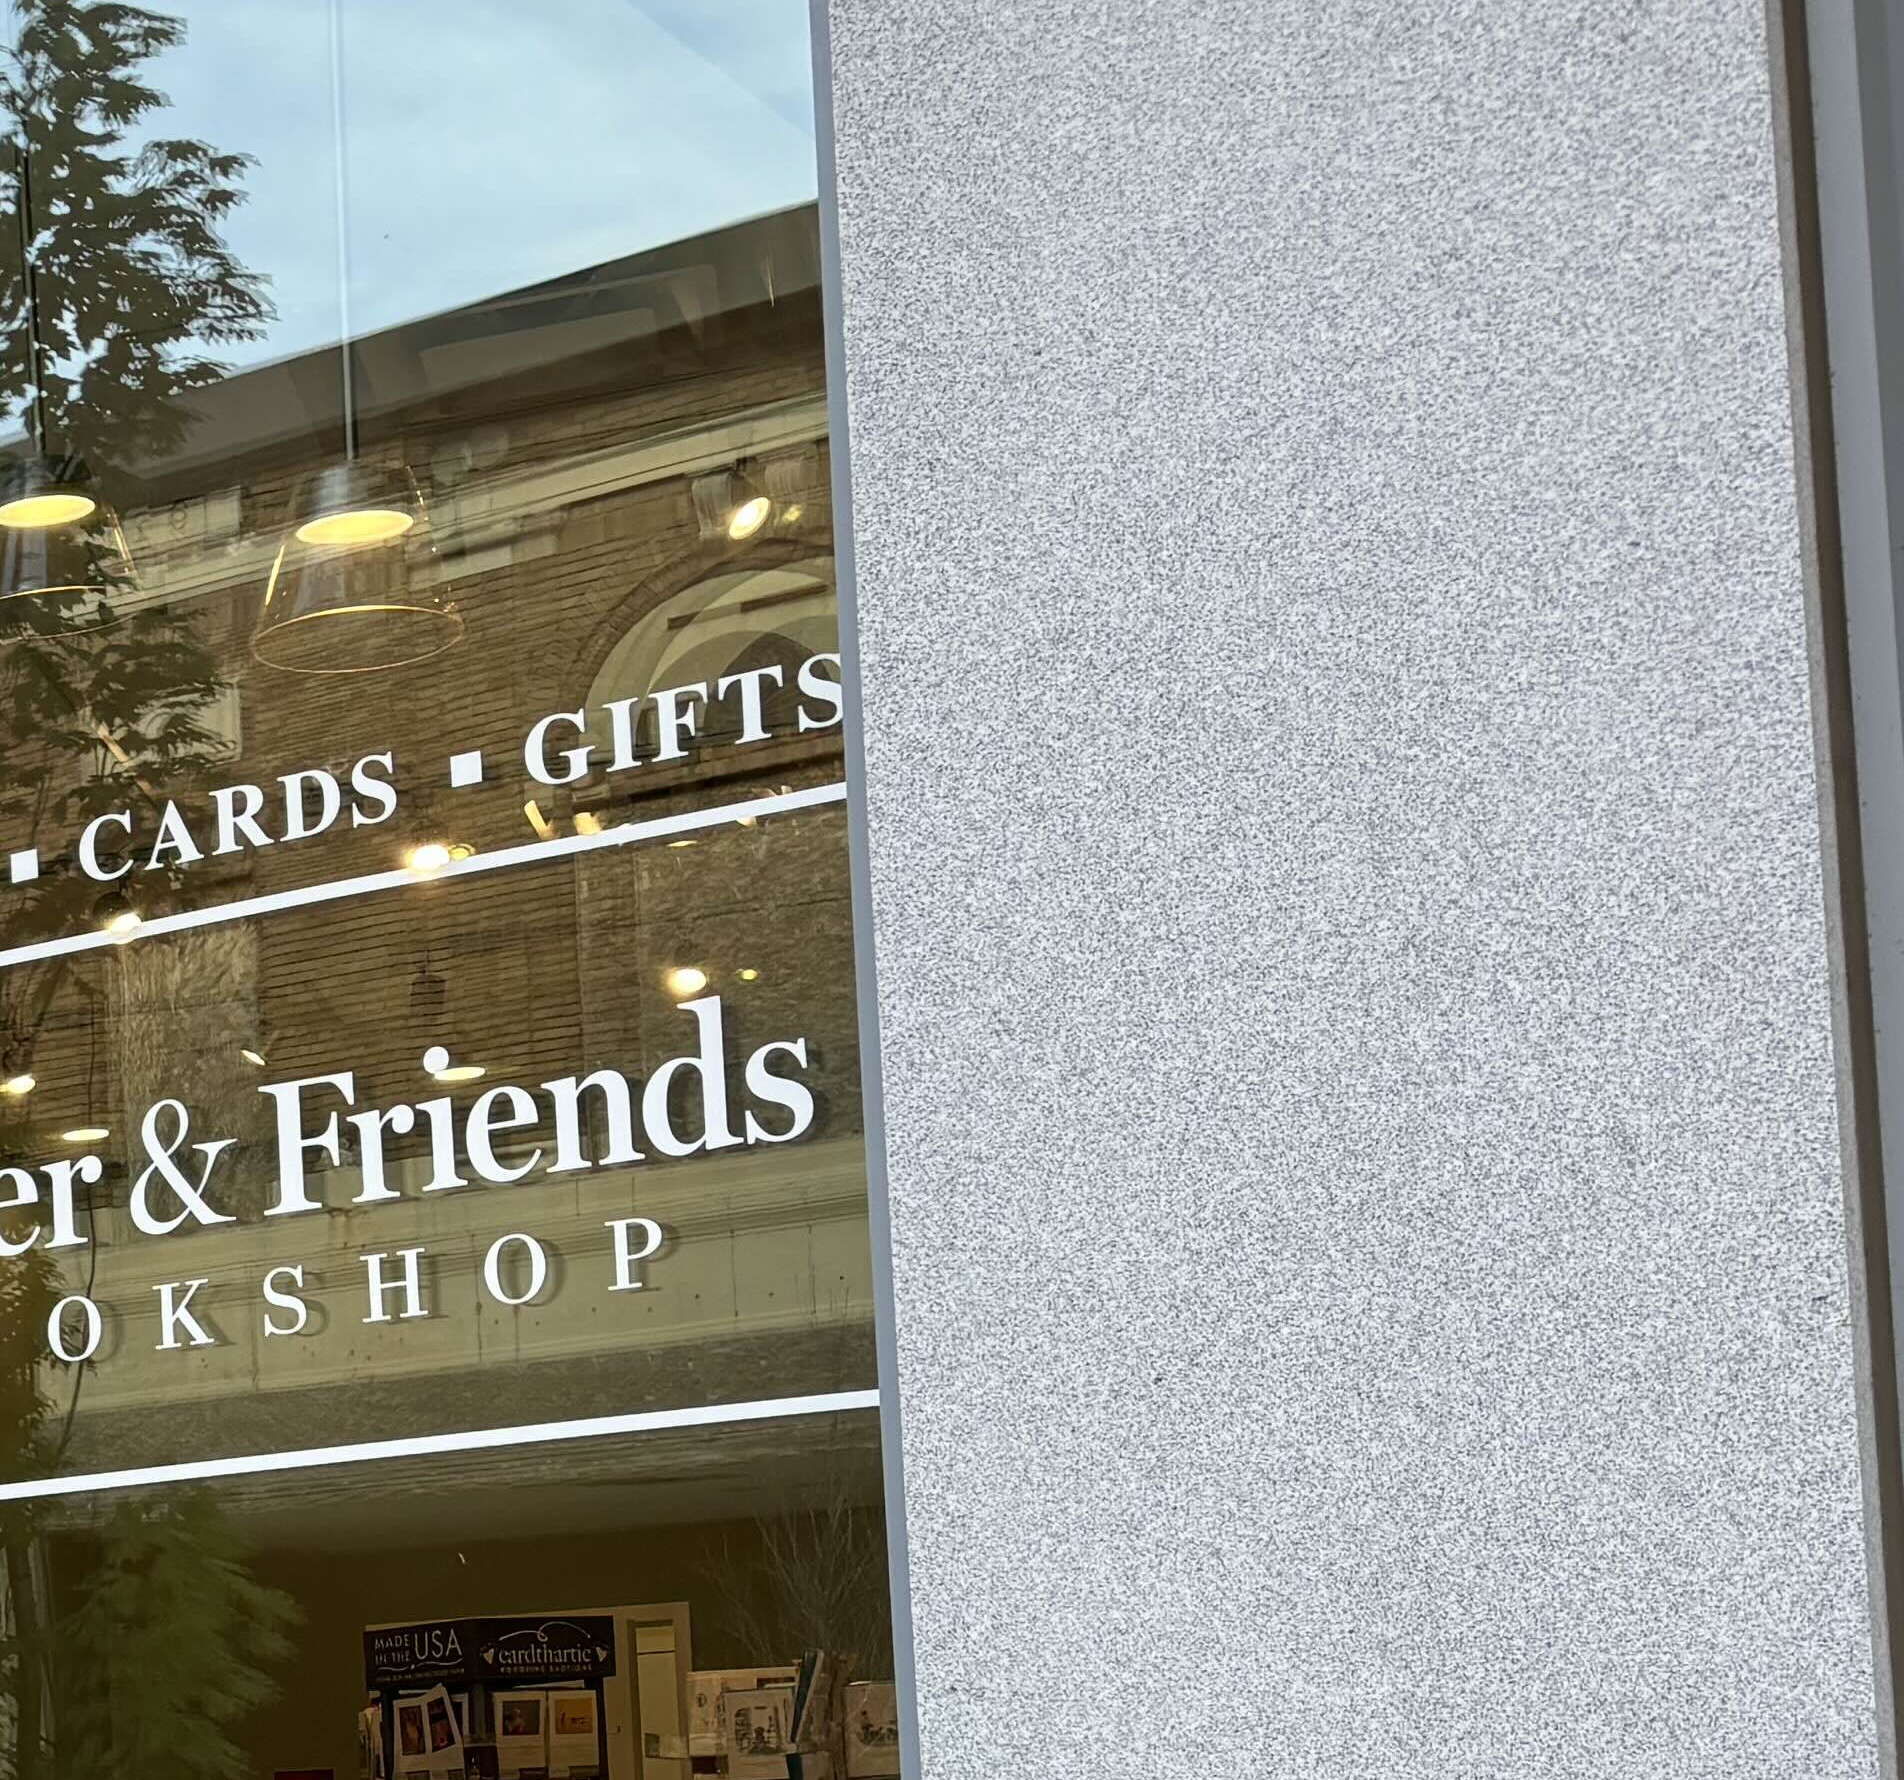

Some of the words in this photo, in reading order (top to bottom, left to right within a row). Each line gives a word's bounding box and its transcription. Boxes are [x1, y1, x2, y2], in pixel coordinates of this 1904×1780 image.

[77, 752, 399, 884] CARDS
[525, 652, 843, 784] GIFTS
[130, 1098, 238, 1238] &
[260, 998, 815, 1218] Friends
[375, 1634, 409, 1651] MADE
[414, 1628, 463, 1660] USA
[498, 1643, 592, 1665] cardthartic
